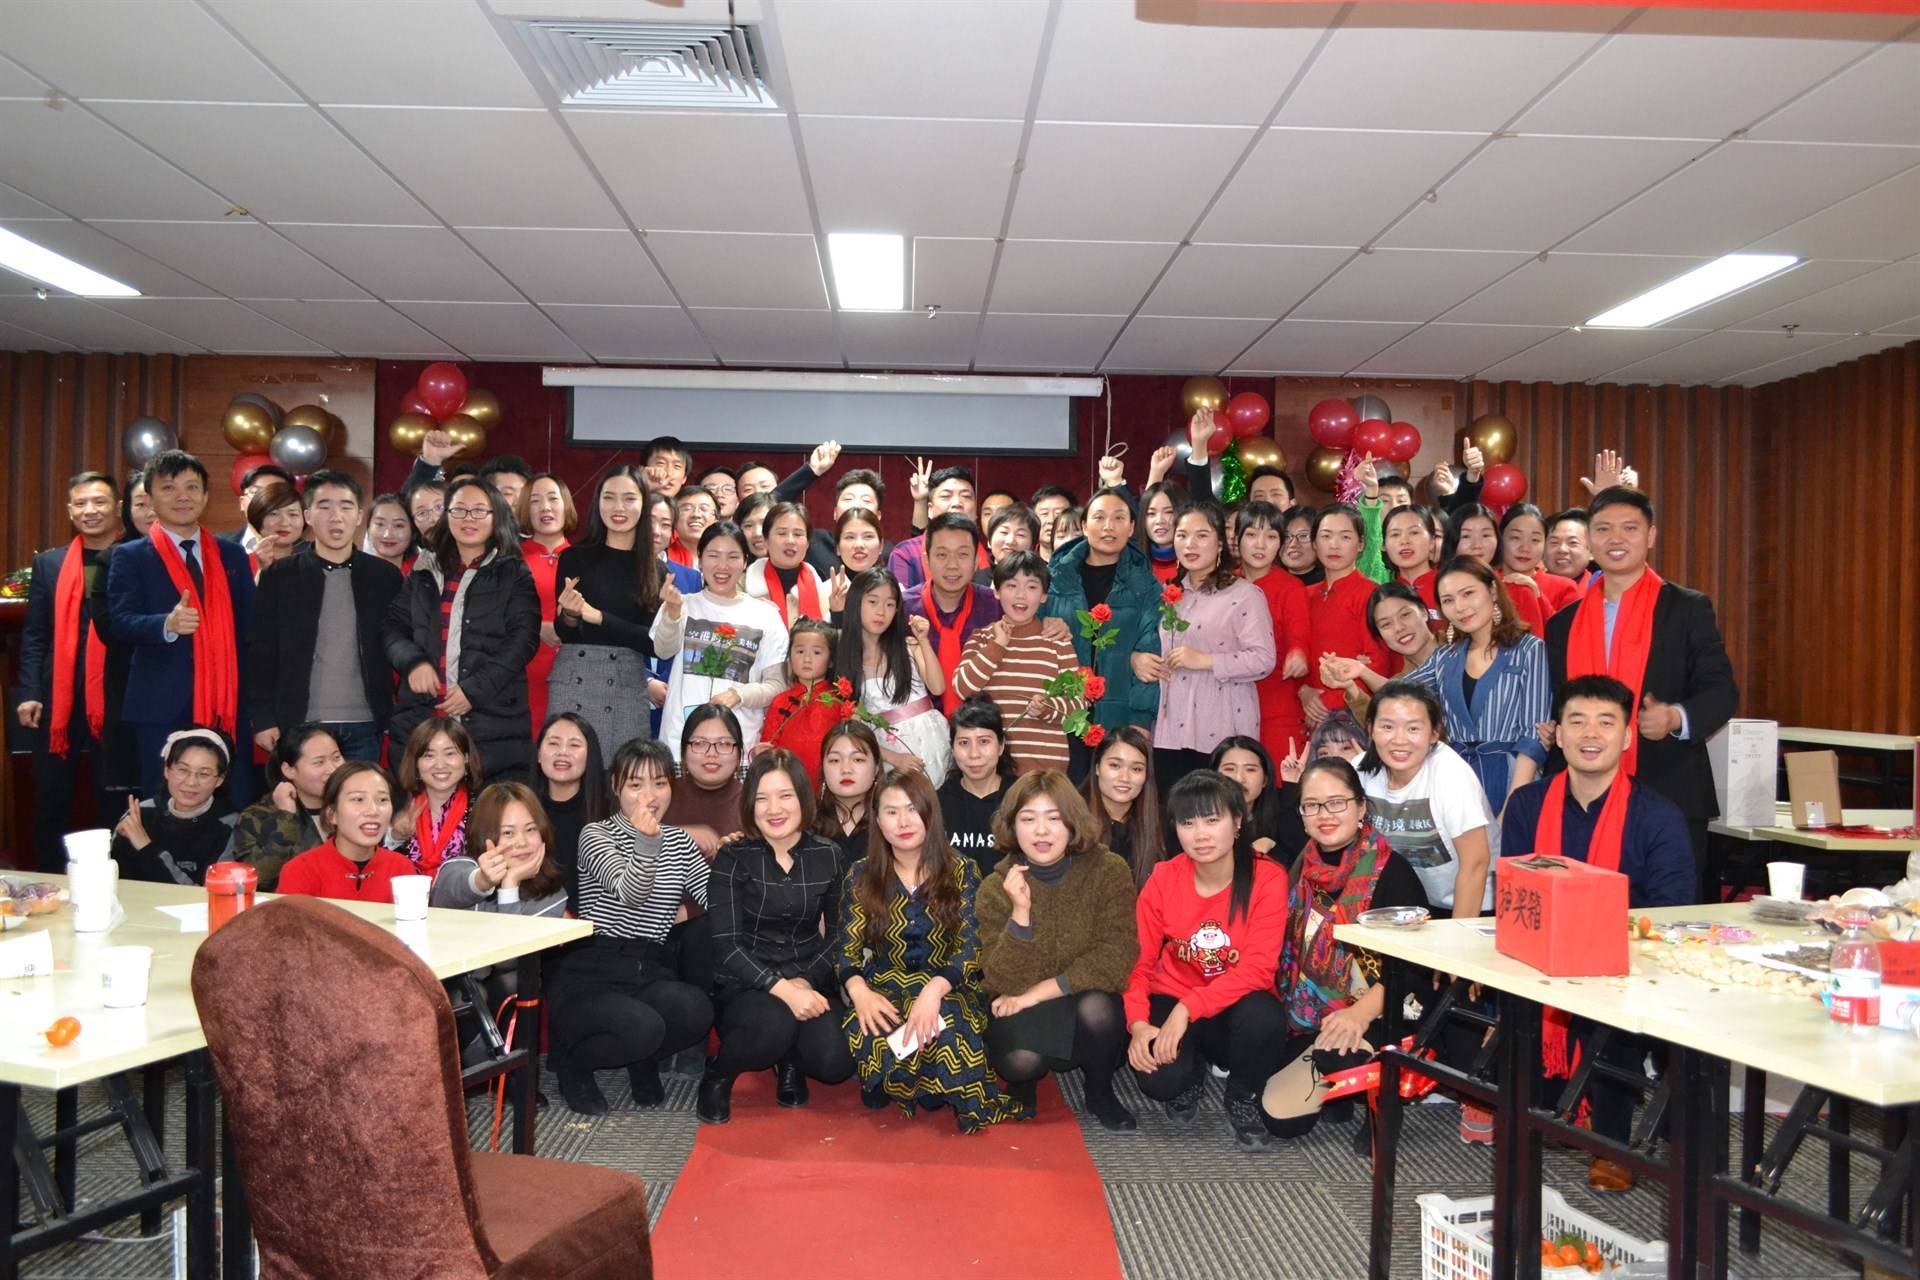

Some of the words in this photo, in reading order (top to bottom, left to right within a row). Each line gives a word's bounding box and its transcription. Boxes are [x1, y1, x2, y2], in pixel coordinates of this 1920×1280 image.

[944, 831, 996, 848] AMAS
[1498, 882, 1541, 930] 抽奖箱
